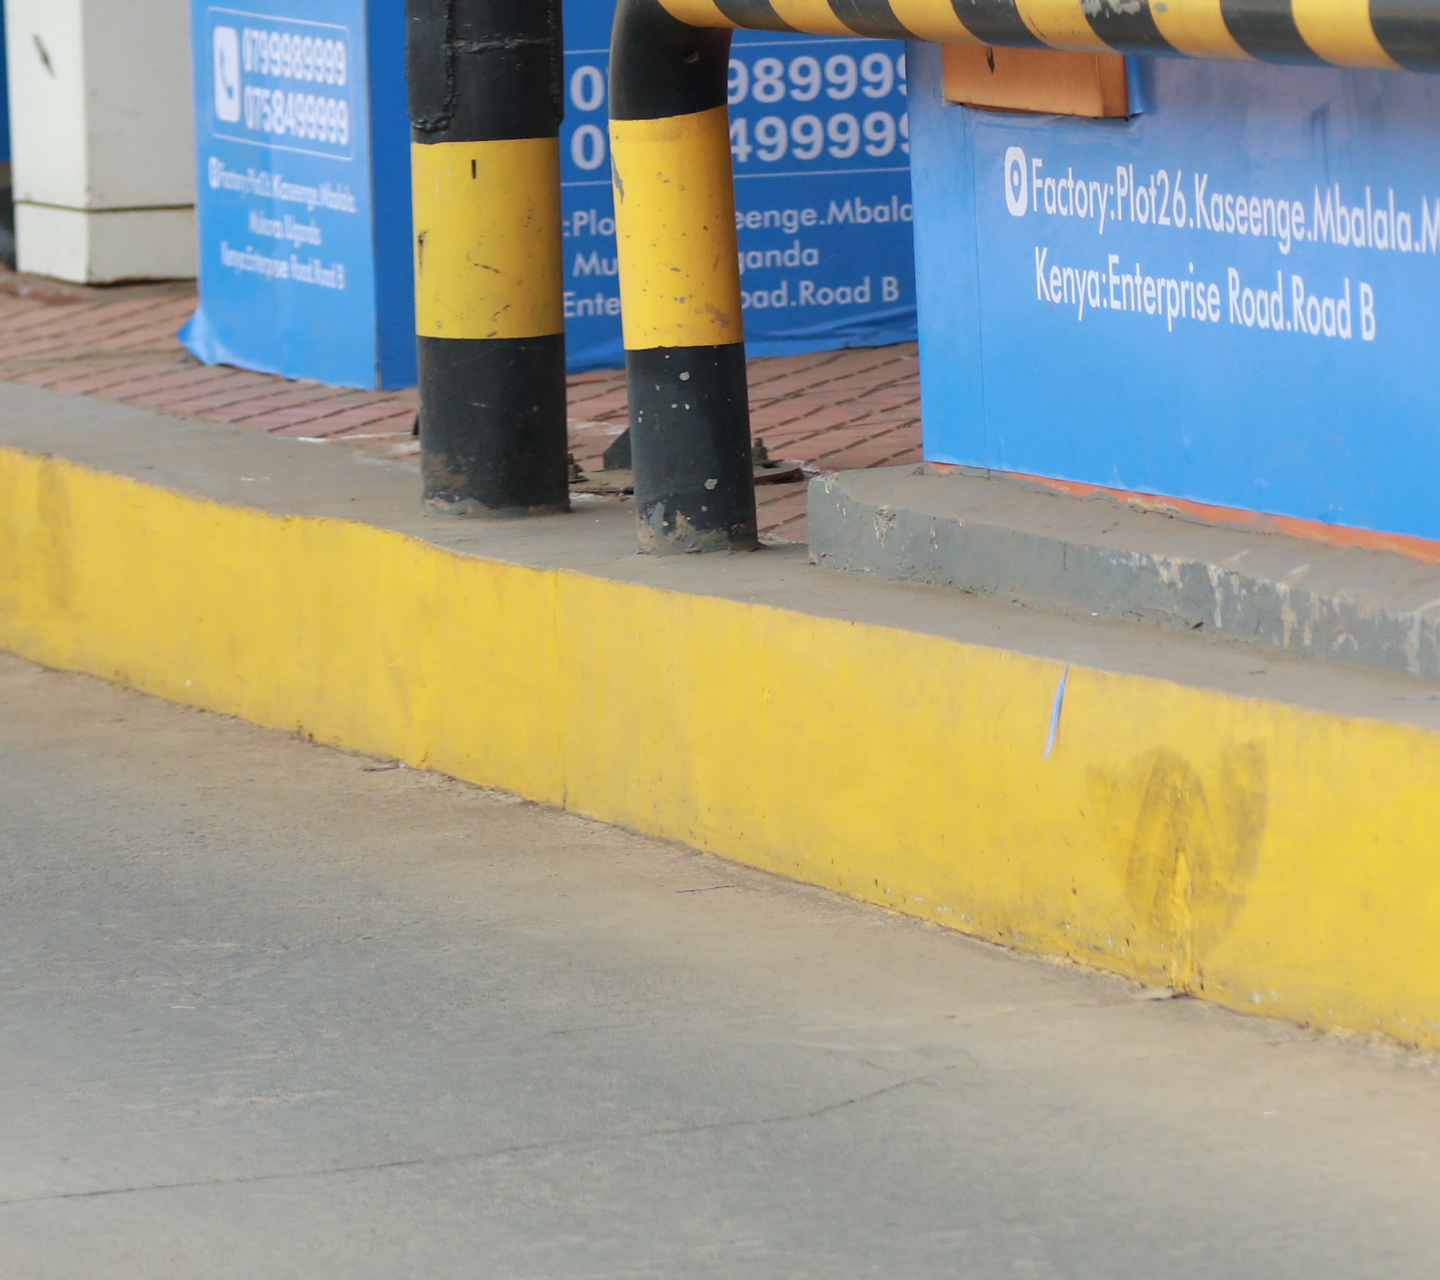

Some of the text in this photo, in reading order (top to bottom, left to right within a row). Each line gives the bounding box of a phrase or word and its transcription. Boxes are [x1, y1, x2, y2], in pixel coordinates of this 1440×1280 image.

[242, 26, 348, 88] 0799989999
[244, 85, 350, 146] 0758499999
[882, 276, 900, 304] B
[1034, 246, 1376, 341] Kenya:Enterprise Road.Road B
